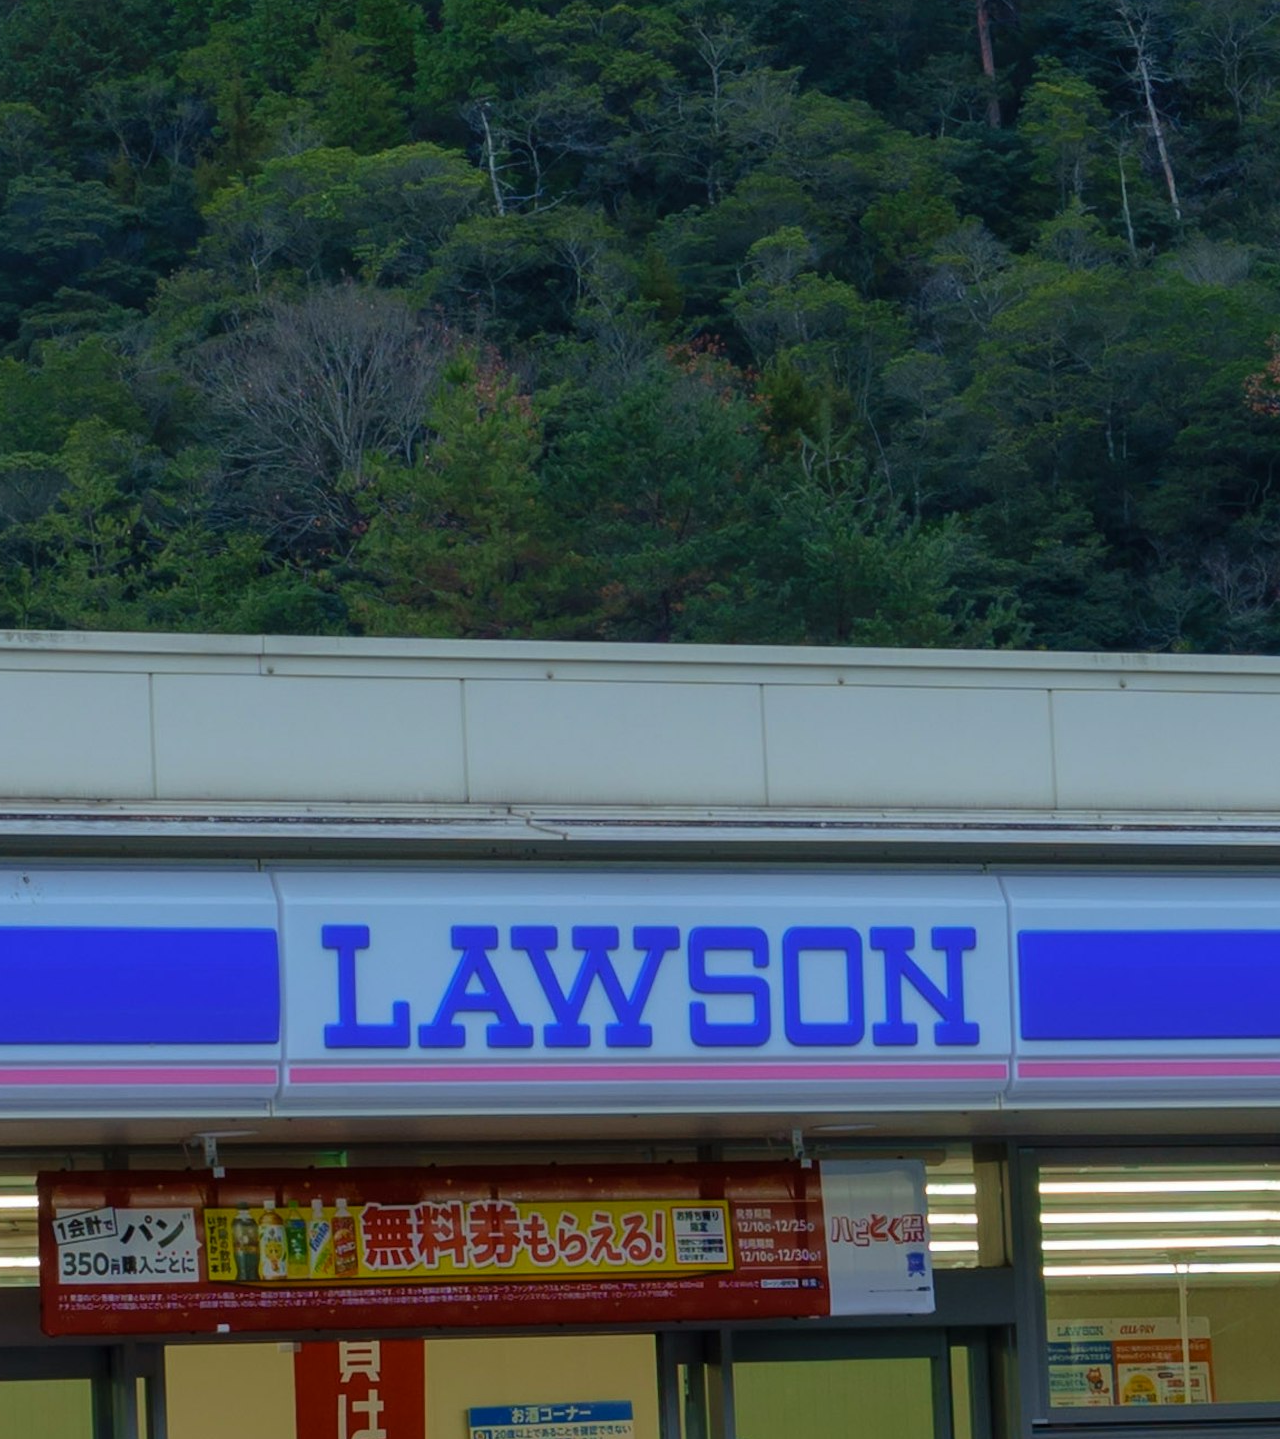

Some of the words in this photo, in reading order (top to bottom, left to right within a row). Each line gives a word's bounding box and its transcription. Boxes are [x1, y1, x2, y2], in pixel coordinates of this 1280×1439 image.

[321, 924, 980, 1049] LAWSON
[56, 1214, 113, 1241] 1会計で
[119, 1214, 184, 1249] パン
[675, 1210, 719, 1222] お持ち帰り
[831, 1213, 925, 1248] ハピとく祭
[207, 1215, 218, 1274] いずれか一本
[361, 1201, 667, 1267] 無料券もらえる!
[62, 1251, 196, 1277] 350円購入ごとに
[493, 1425, 632, 1439] 20歳以上であることを確認できない
[511, 1407, 592, 1424] お酒コーナー
